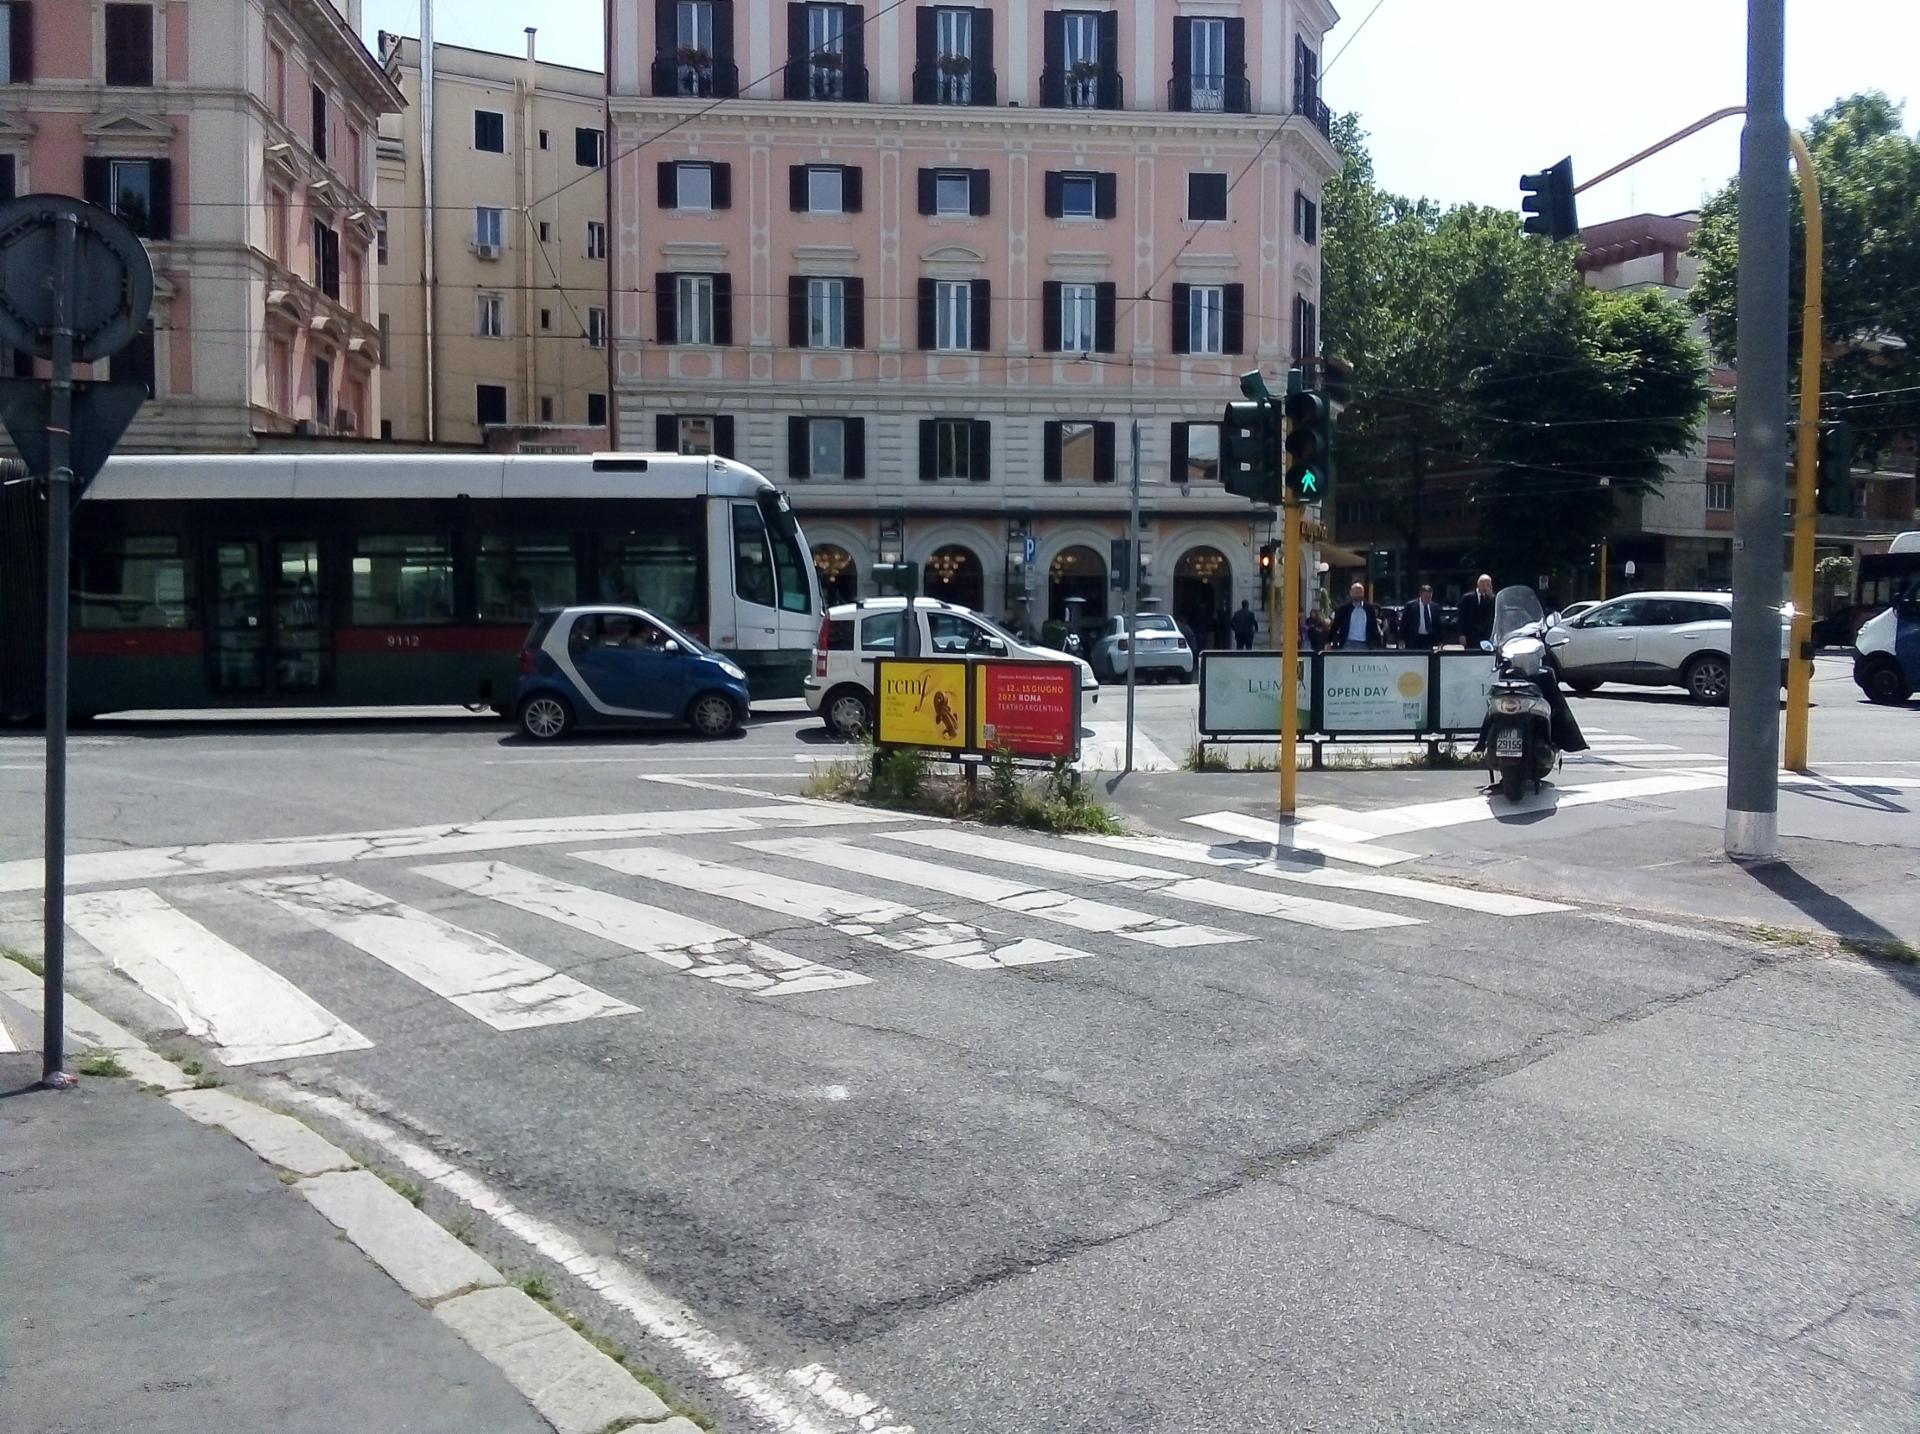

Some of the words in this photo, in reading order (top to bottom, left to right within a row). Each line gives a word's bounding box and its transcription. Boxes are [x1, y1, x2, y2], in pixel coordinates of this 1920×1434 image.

[1026, 539, 1034, 561] P
[387, 635, 420, 647] 9112
[1351, 664, 1389, 673] LUMSA
[1007, 684, 1015, 692] 12
[1022, 684, 1031, 693] 15
[1031, 685, 1064, 694] GIUGNO
[1248, 679, 1307, 693] LUMA
[1327, 687, 1360, 698] OPEN
[1364, 686, 1389, 697] DAY
[1018, 694, 1042, 702] ROMA
[998, 703, 1024, 711] TEATRO
[1025, 704, 1064, 713] ARGENTINA
